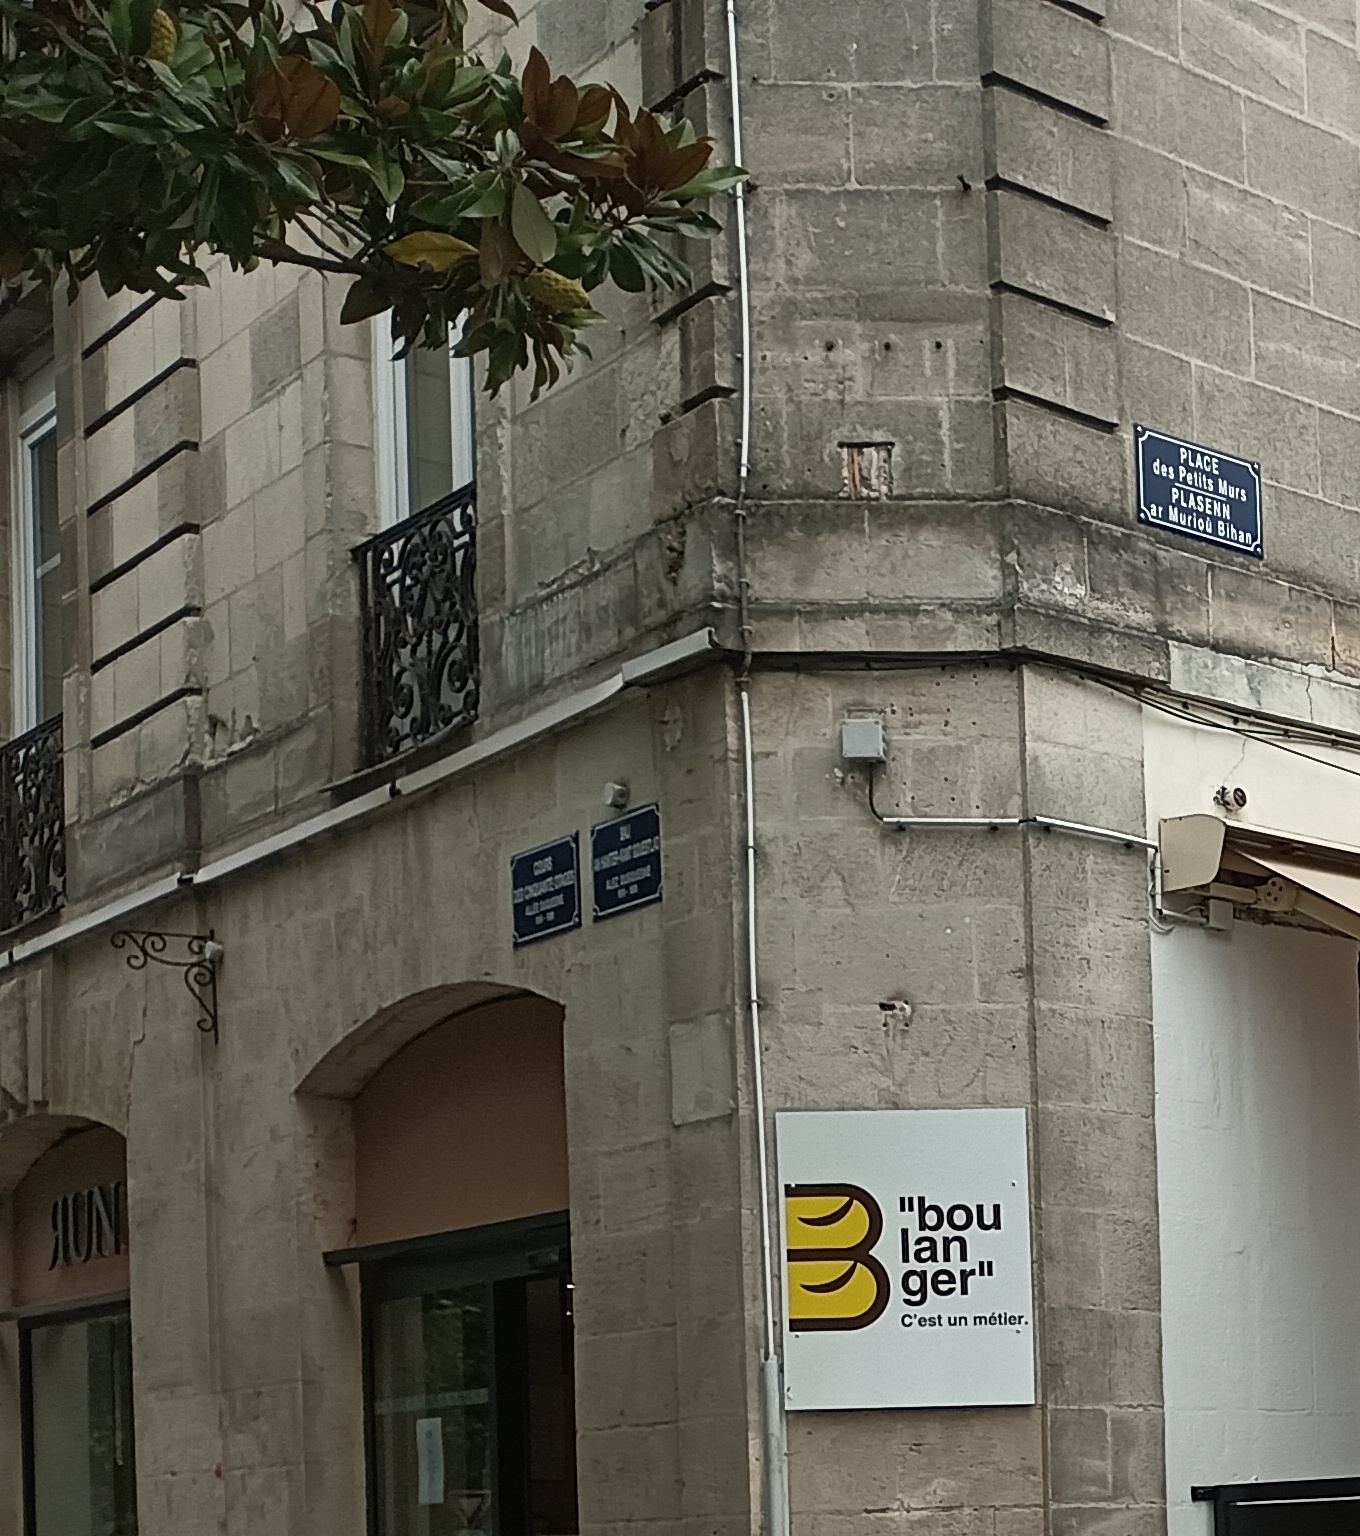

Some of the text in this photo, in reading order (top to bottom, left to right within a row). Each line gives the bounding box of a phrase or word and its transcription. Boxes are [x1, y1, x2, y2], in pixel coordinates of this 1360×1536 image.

[1179, 448, 1219, 475] PLACE
[1153, 458, 1247, 502] des Petits Murs
[1171, 487, 1231, 520] PLASENN
[1150, 503, 1164, 518] ar
[1217, 521, 1252, 545] Bihan
[901, 1228, 968, 1263] lan
[900, 1313, 1029, 1328] C'est un métier.
